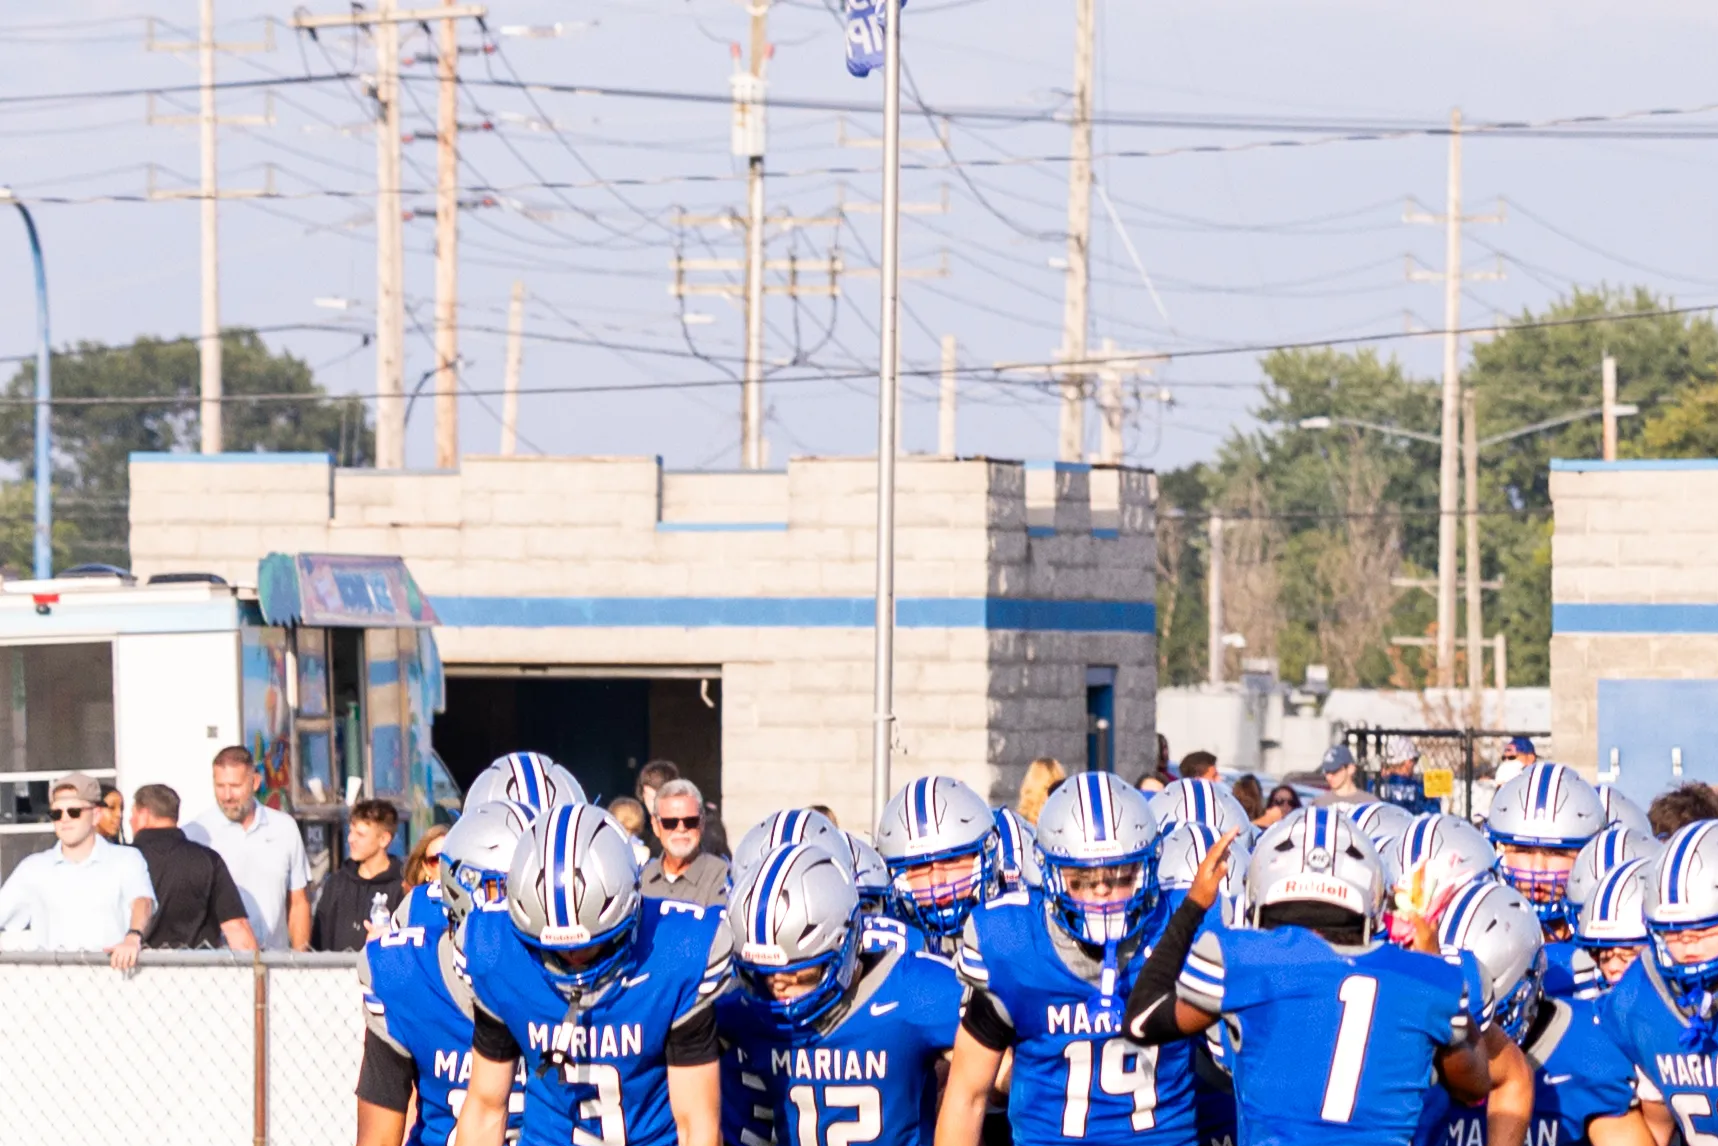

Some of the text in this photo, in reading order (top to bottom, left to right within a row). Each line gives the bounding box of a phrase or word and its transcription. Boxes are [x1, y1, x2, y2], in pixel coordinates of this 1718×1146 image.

[771, 1047, 887, 1080] MARIAN
[1062, 1039, 1159, 1138] 19
[1321, 974, 1378, 1124] 1
